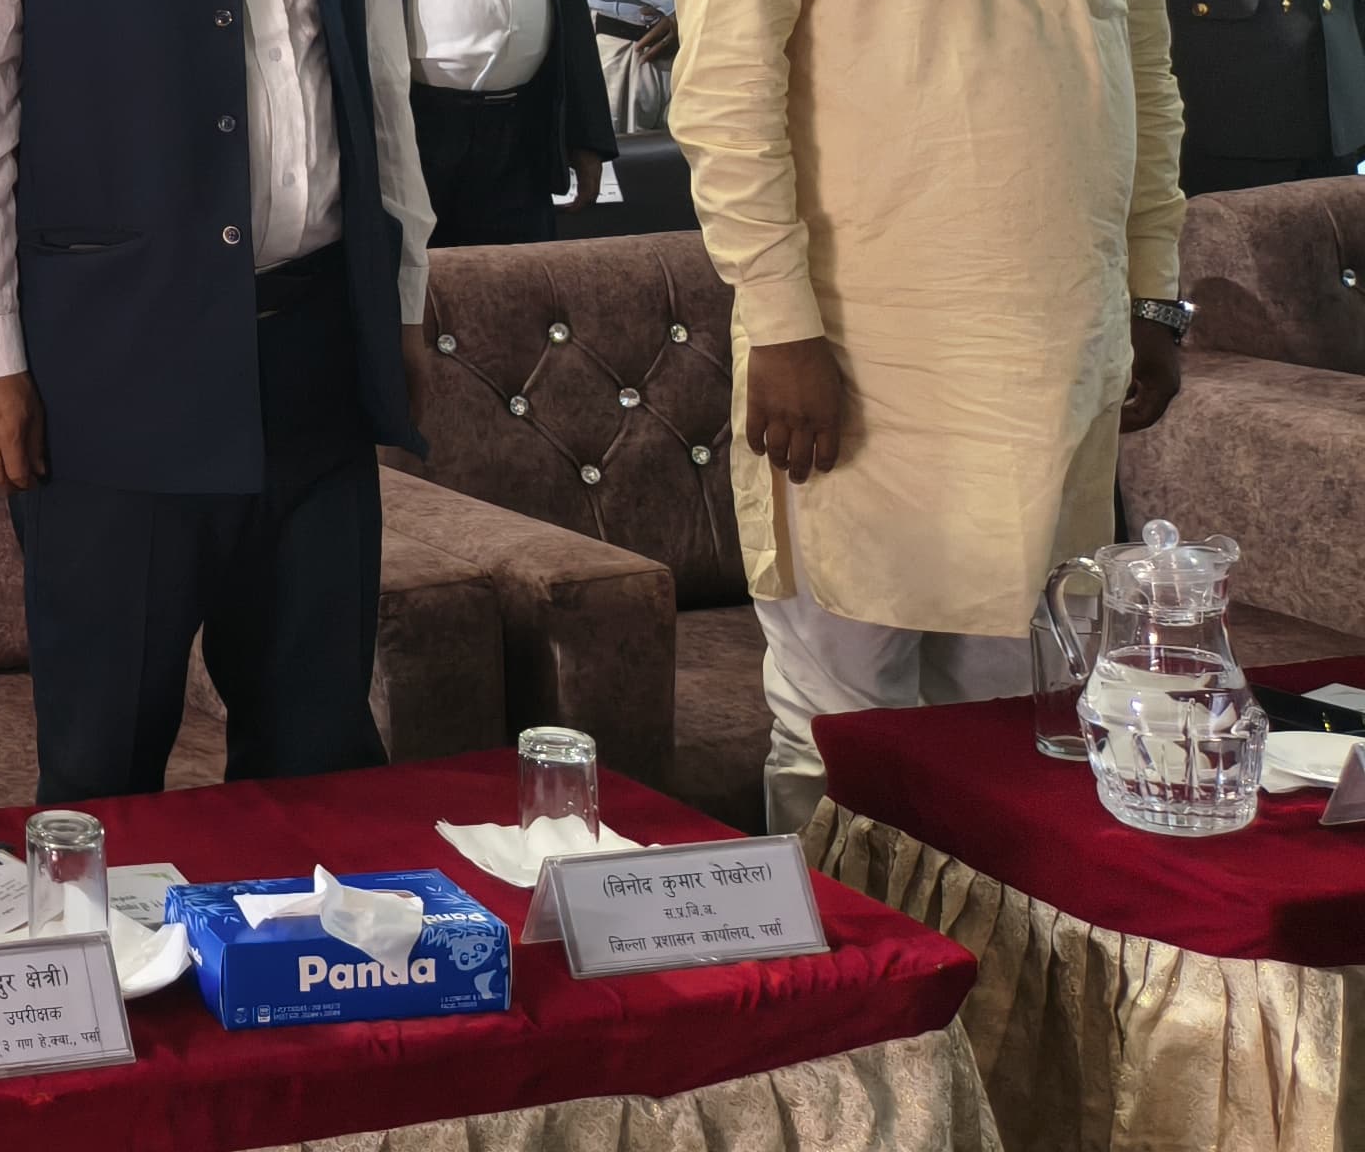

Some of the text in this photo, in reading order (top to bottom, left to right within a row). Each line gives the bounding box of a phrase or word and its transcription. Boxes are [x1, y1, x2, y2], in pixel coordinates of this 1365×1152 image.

[602, 862, 772, 898] (बिनोद कुमार पोखरेल)
[422, 913, 488, 926] Pand
[608, 935, 647, 953] जिल्ला
[652, 932, 696, 949] प्रशासन
[759, 918, 784, 937] पर्सा
[26, 964, 69, 989] क्षेत्री)
[3, 1005, 63, 1026] उपरीक्षक
[17, 1038, 34, 1050] गण
